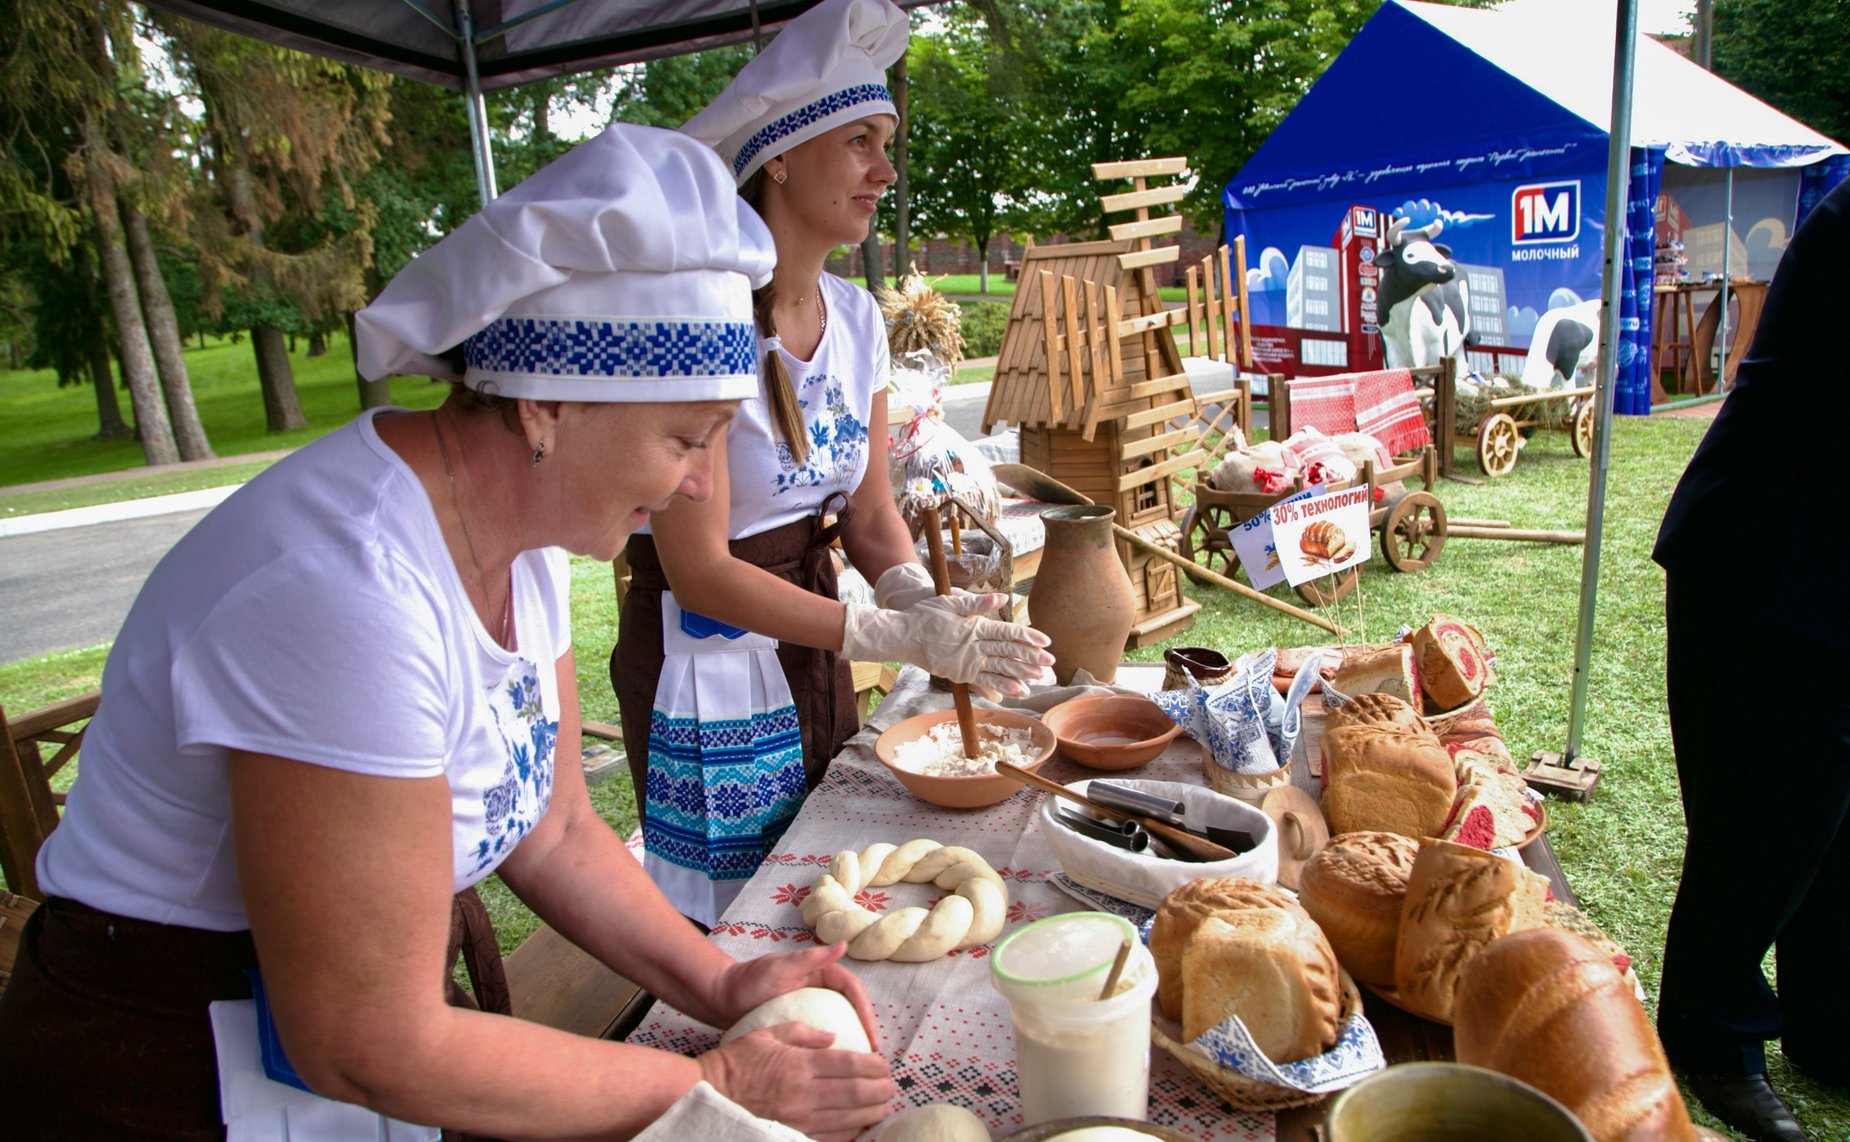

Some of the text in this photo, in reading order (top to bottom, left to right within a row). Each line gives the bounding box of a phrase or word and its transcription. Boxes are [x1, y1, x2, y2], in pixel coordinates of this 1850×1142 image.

[1519, 191, 1569, 234] 1М
[1511, 243, 1579, 261] МОЛОЧНЫЙ
[1243, 508, 1271, 532] 50%
[1273, 503, 1299, 526] 30%
